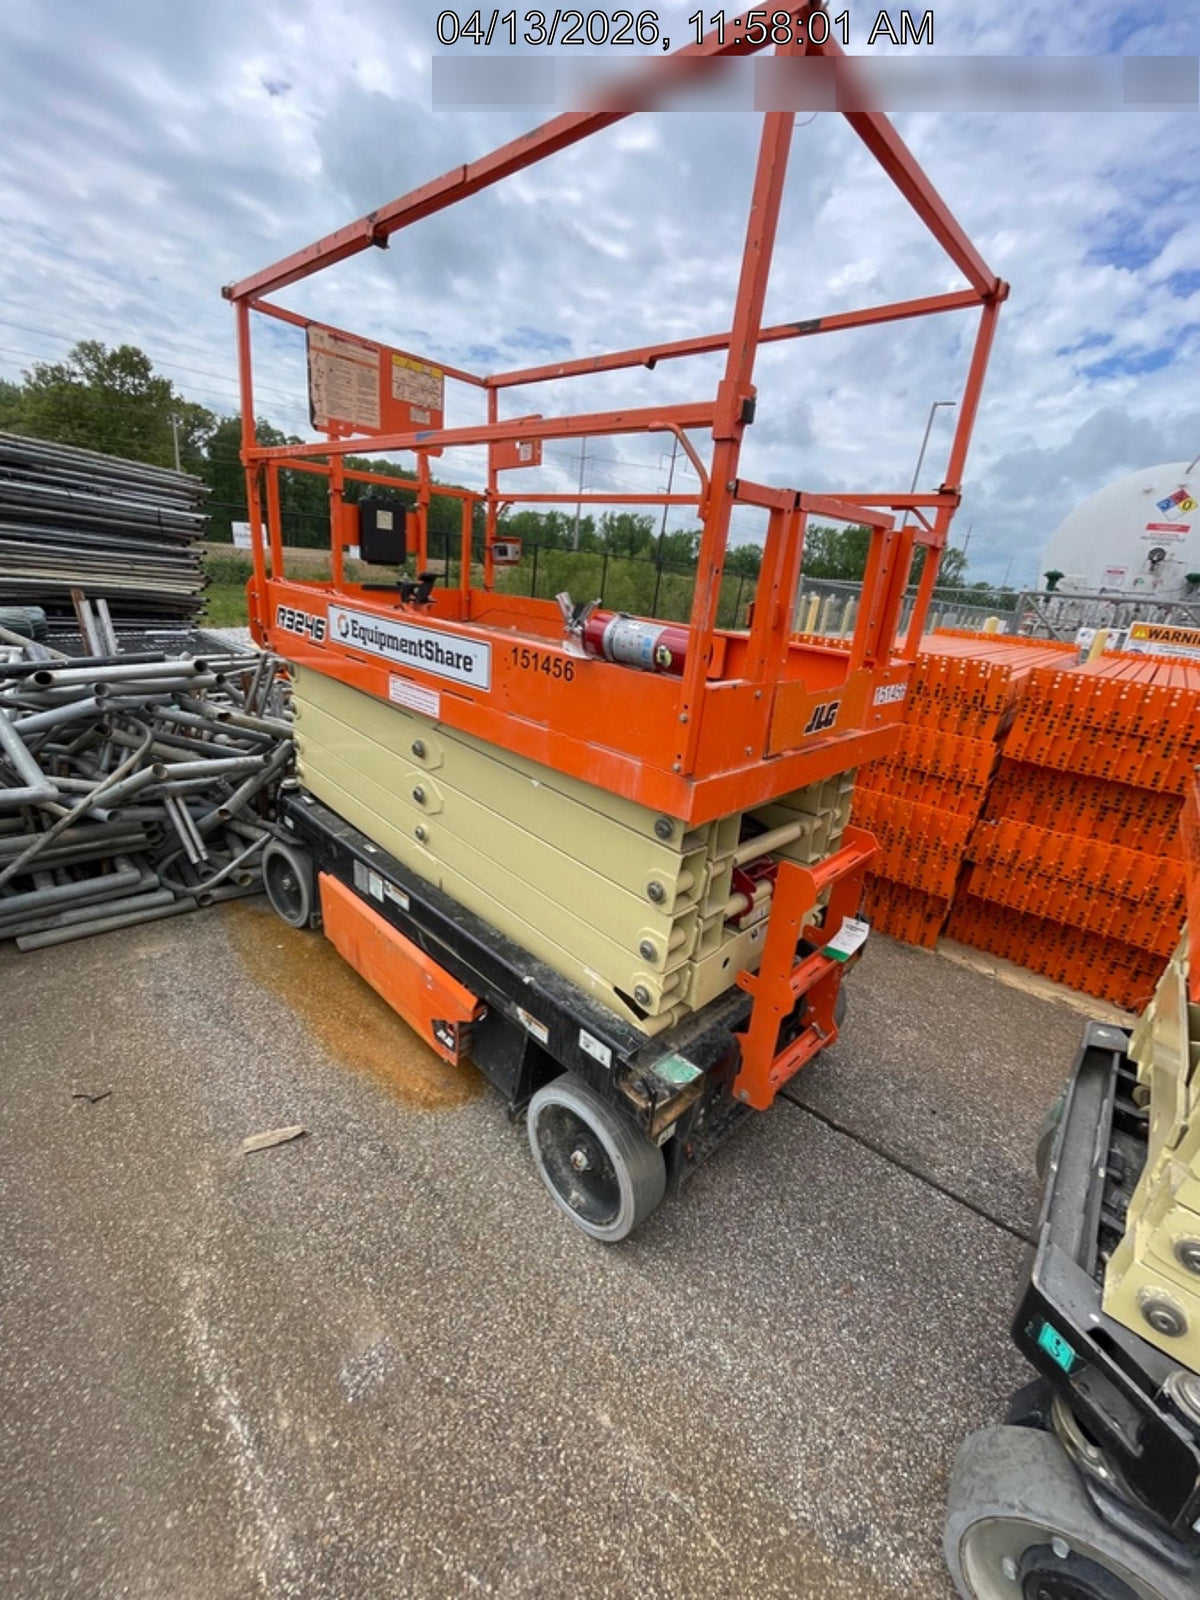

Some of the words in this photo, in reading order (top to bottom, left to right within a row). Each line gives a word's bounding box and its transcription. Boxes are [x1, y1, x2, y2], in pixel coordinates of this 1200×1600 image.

[276, 605, 327, 642] R3246
[1148, 628, 1200, 645] WARNI
[350, 619, 474, 673] EquipmentShare
[511, 646, 575, 682] 151456
[804, 701, 840, 733] JLG
